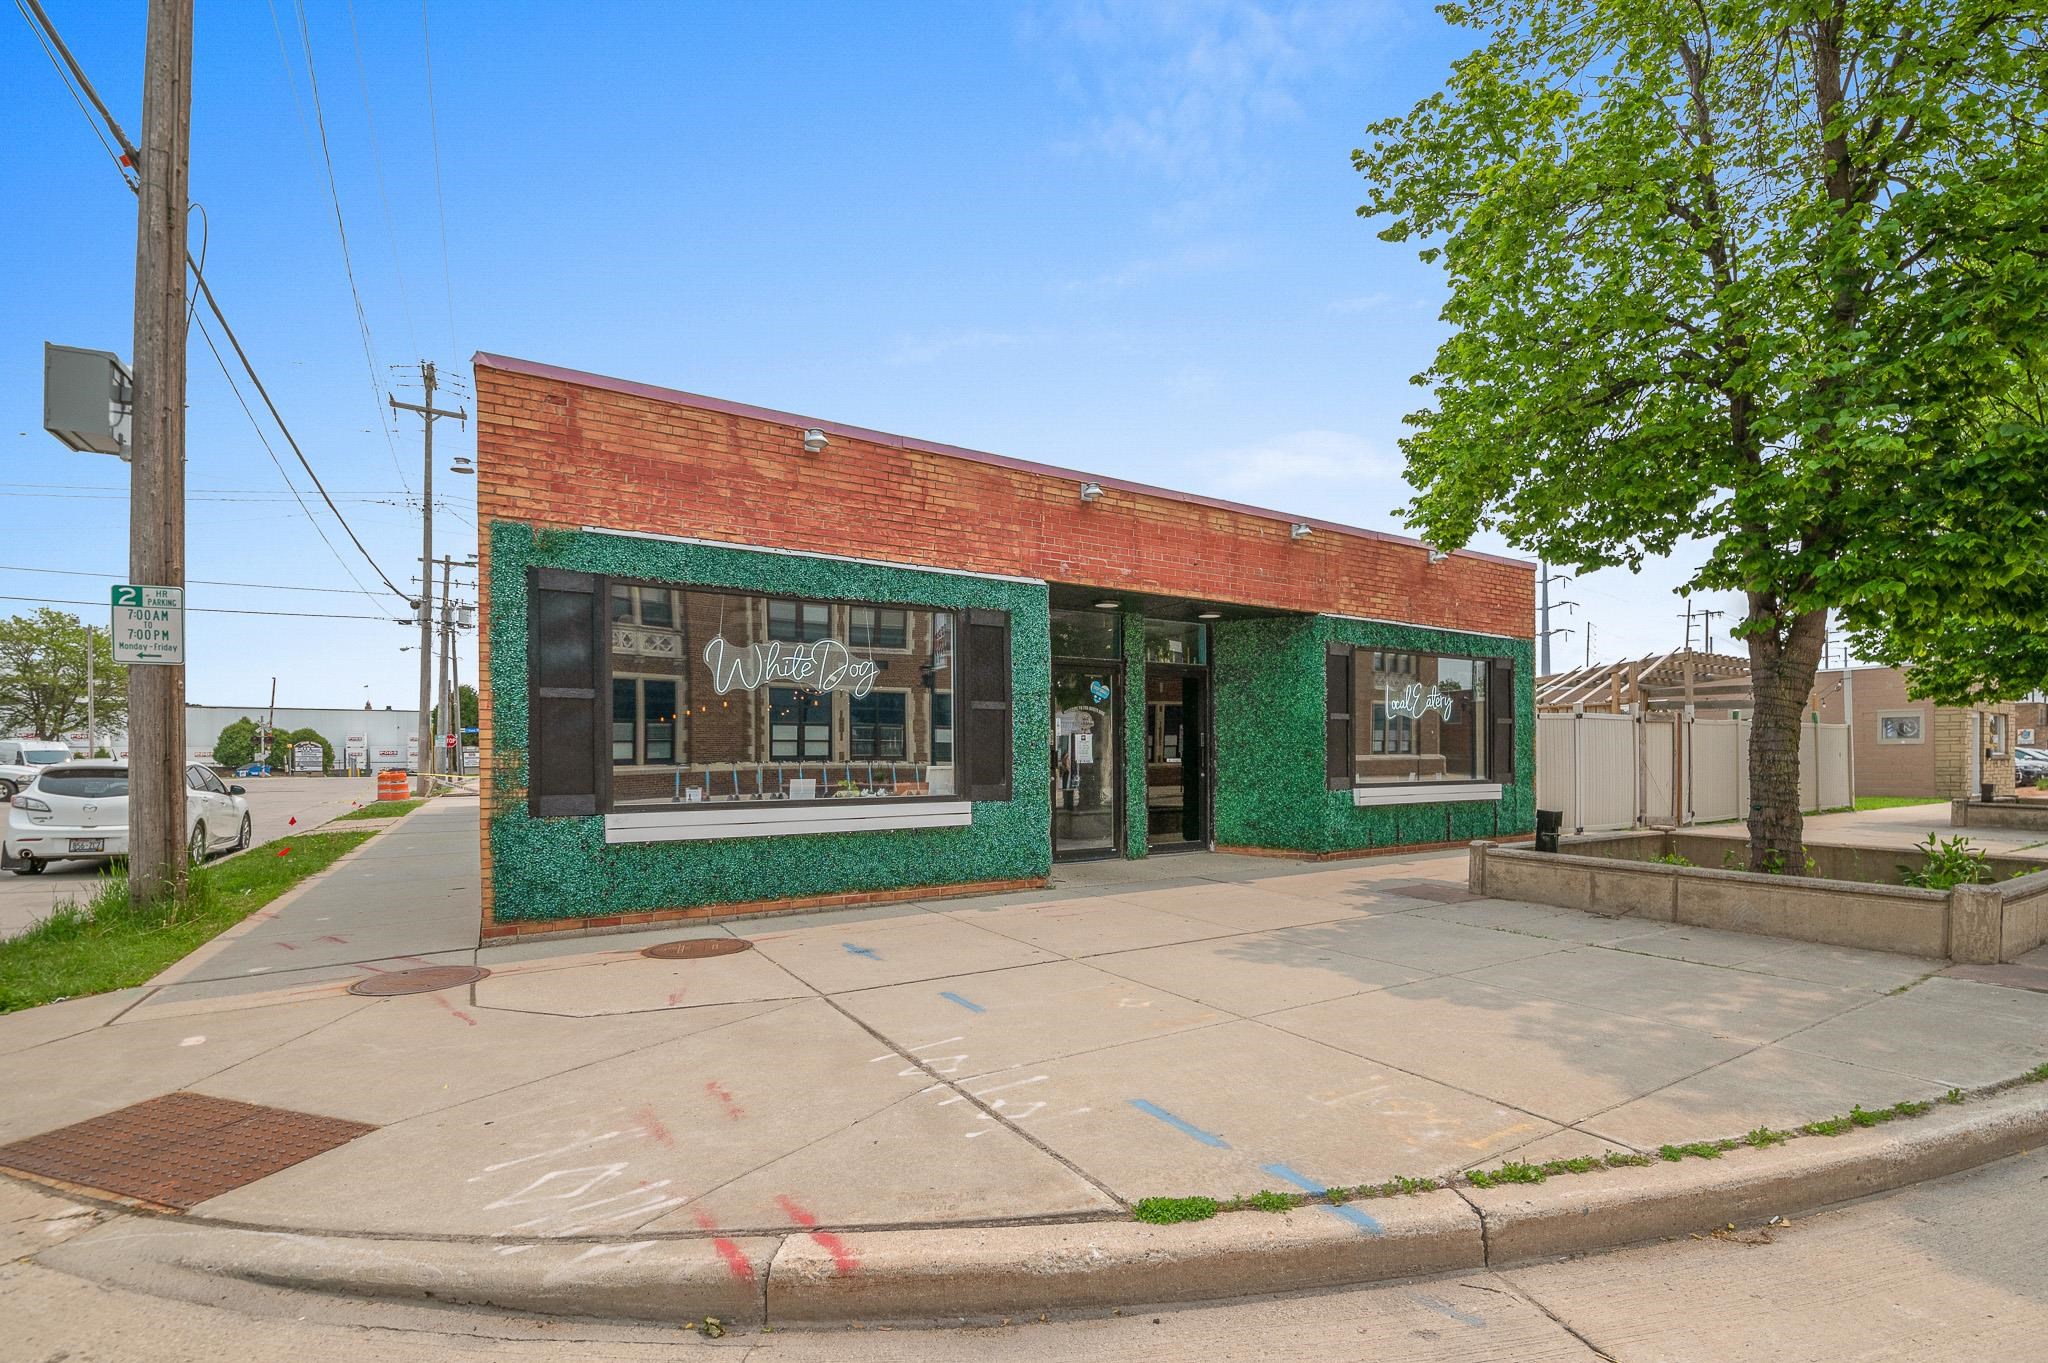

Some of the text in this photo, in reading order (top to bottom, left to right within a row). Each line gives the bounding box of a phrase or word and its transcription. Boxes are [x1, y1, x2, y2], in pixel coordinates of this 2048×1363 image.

[118, 587, 137, 606] 2
[155, 590, 168, 598] HR
[147, 598, 177, 607] PARKING
[144, 621, 153, 629] TO
